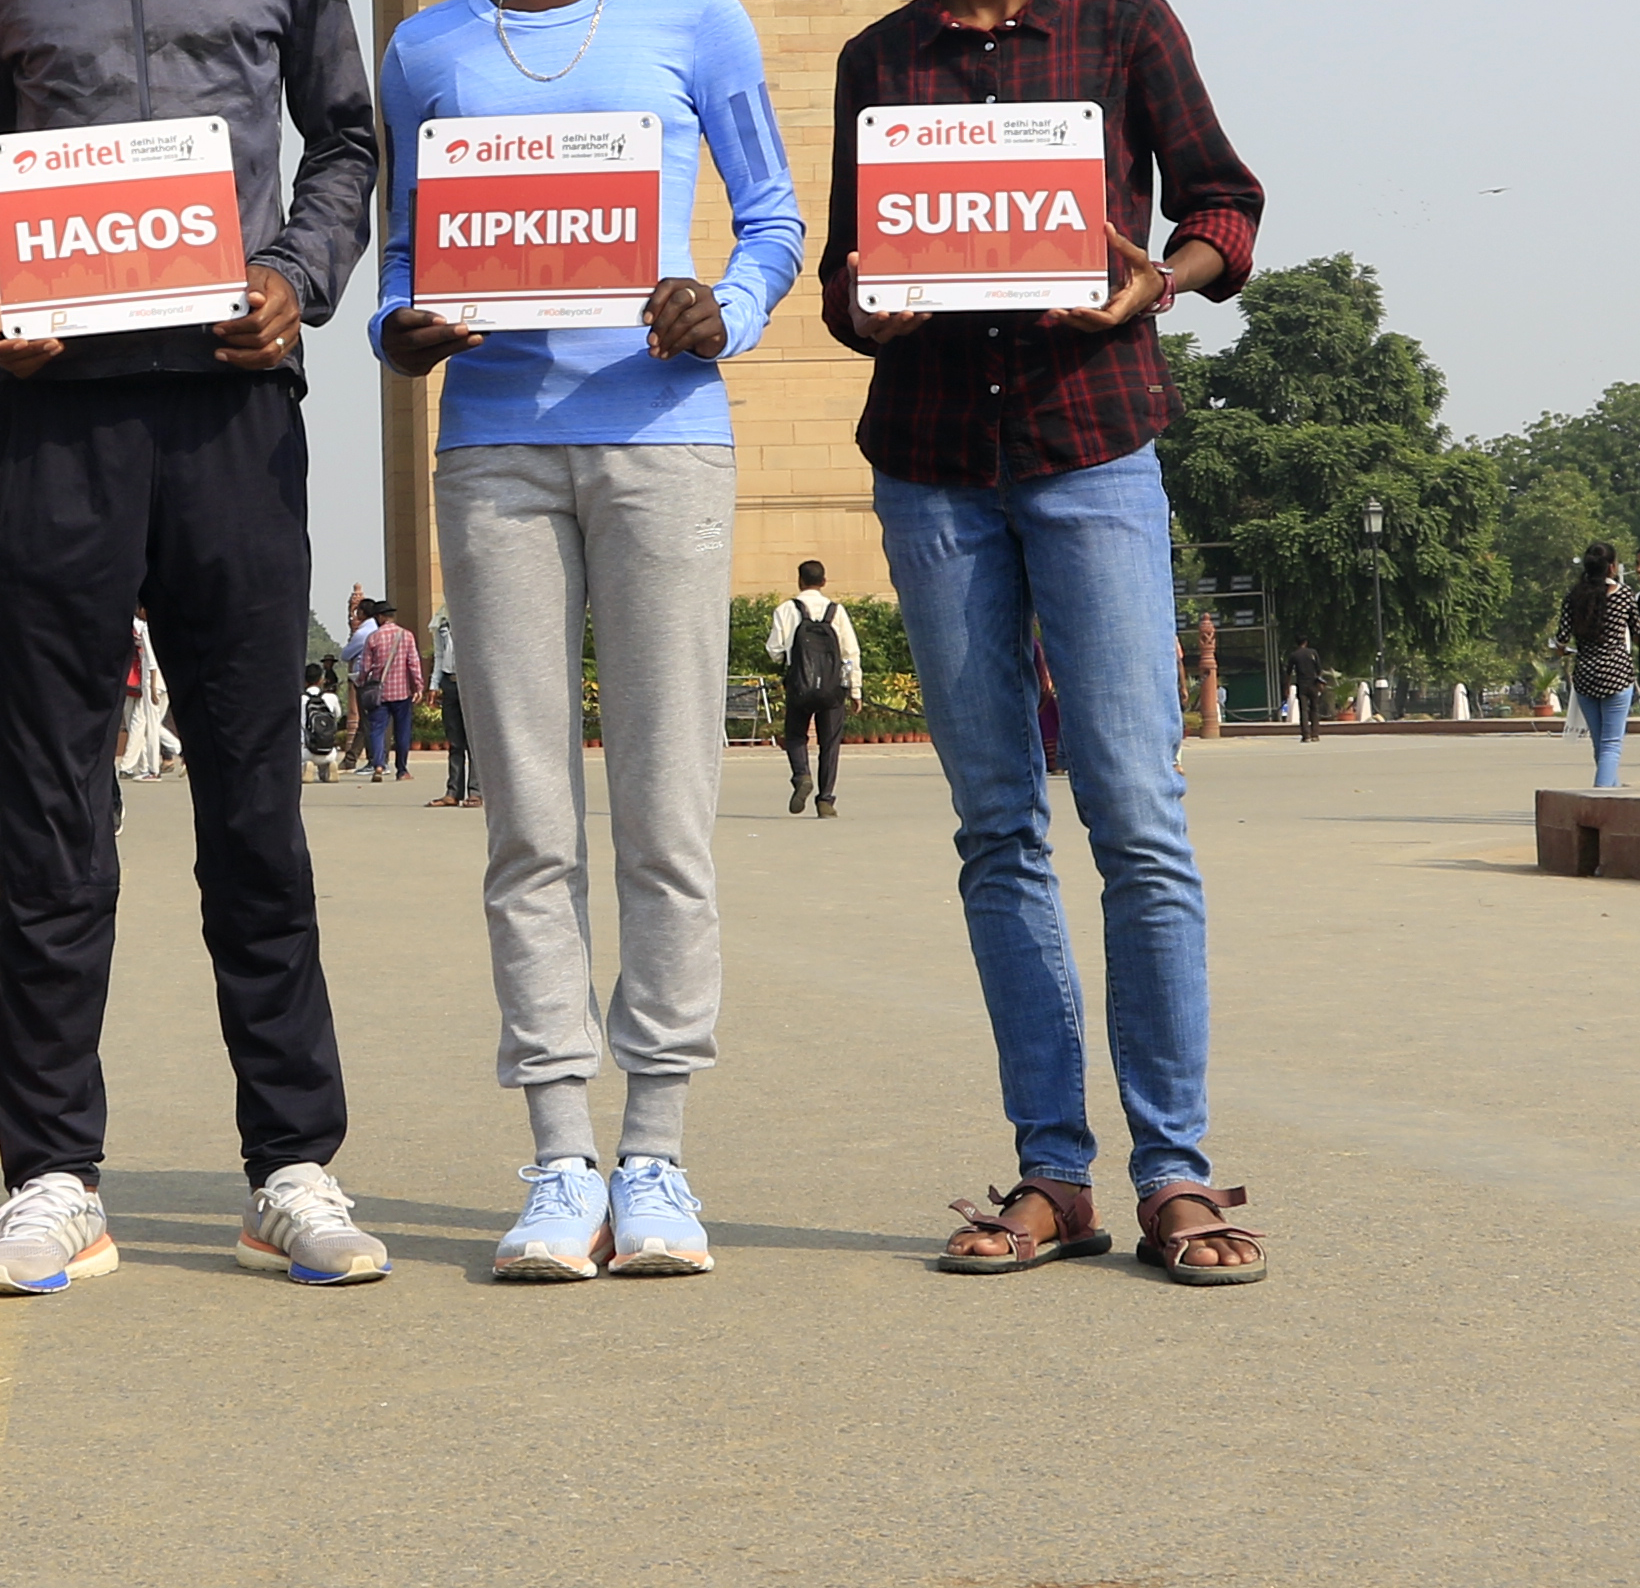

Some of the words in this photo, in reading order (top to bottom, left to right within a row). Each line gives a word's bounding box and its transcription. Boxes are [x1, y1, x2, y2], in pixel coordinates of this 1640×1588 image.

[916, 119, 997, 146] airtel
[1003, 120, 1029, 128] delhi
[1031, 120, 1051, 128] half
[1003, 128, 1051, 136] marathon
[130, 137, 155, 147] delhi
[157, 135, 177, 145] half
[562, 134, 588, 143] delhi
[589, 133, 610, 142] half
[562, 142, 608, 151] marathon
[44, 140, 125, 171] airtel
[131, 144, 178, 154] marathon
[476, 134, 555, 162] airtel
[876, 190, 1087, 235] SURIYA
[14, 204, 218, 262] HAGOS
[437, 207, 637, 248] KIPKIRUI
